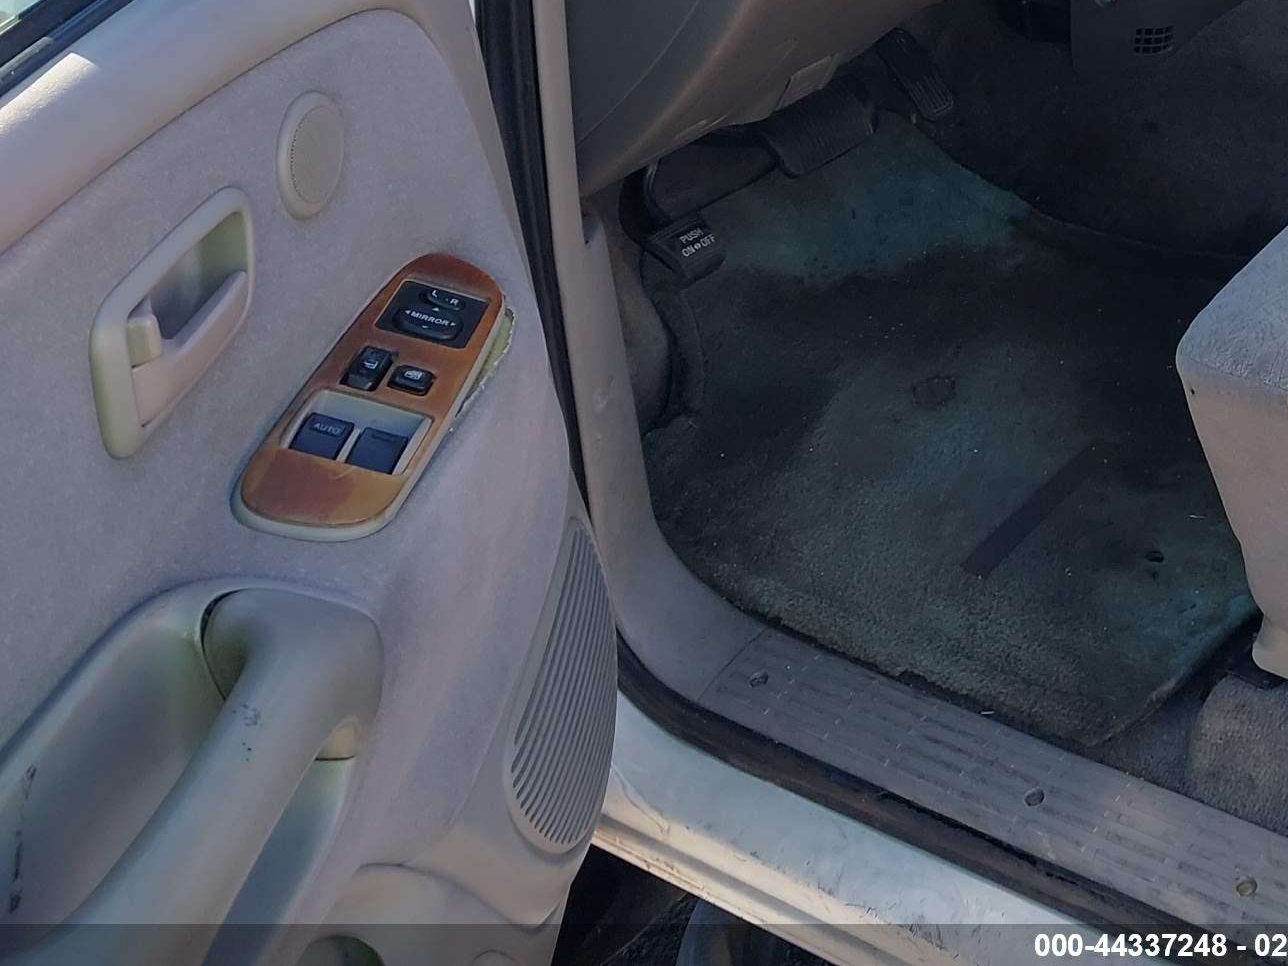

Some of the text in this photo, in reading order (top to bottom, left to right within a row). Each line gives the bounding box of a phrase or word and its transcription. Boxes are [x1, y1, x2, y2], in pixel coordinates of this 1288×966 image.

[680, 227, 703, 244] PUSH
[681, 233, 716, 257] ON OFF
[431, 289, 460, 306] L R
[411, 311, 449, 326] MIRROR
[314, 422, 341, 435] AUTO
